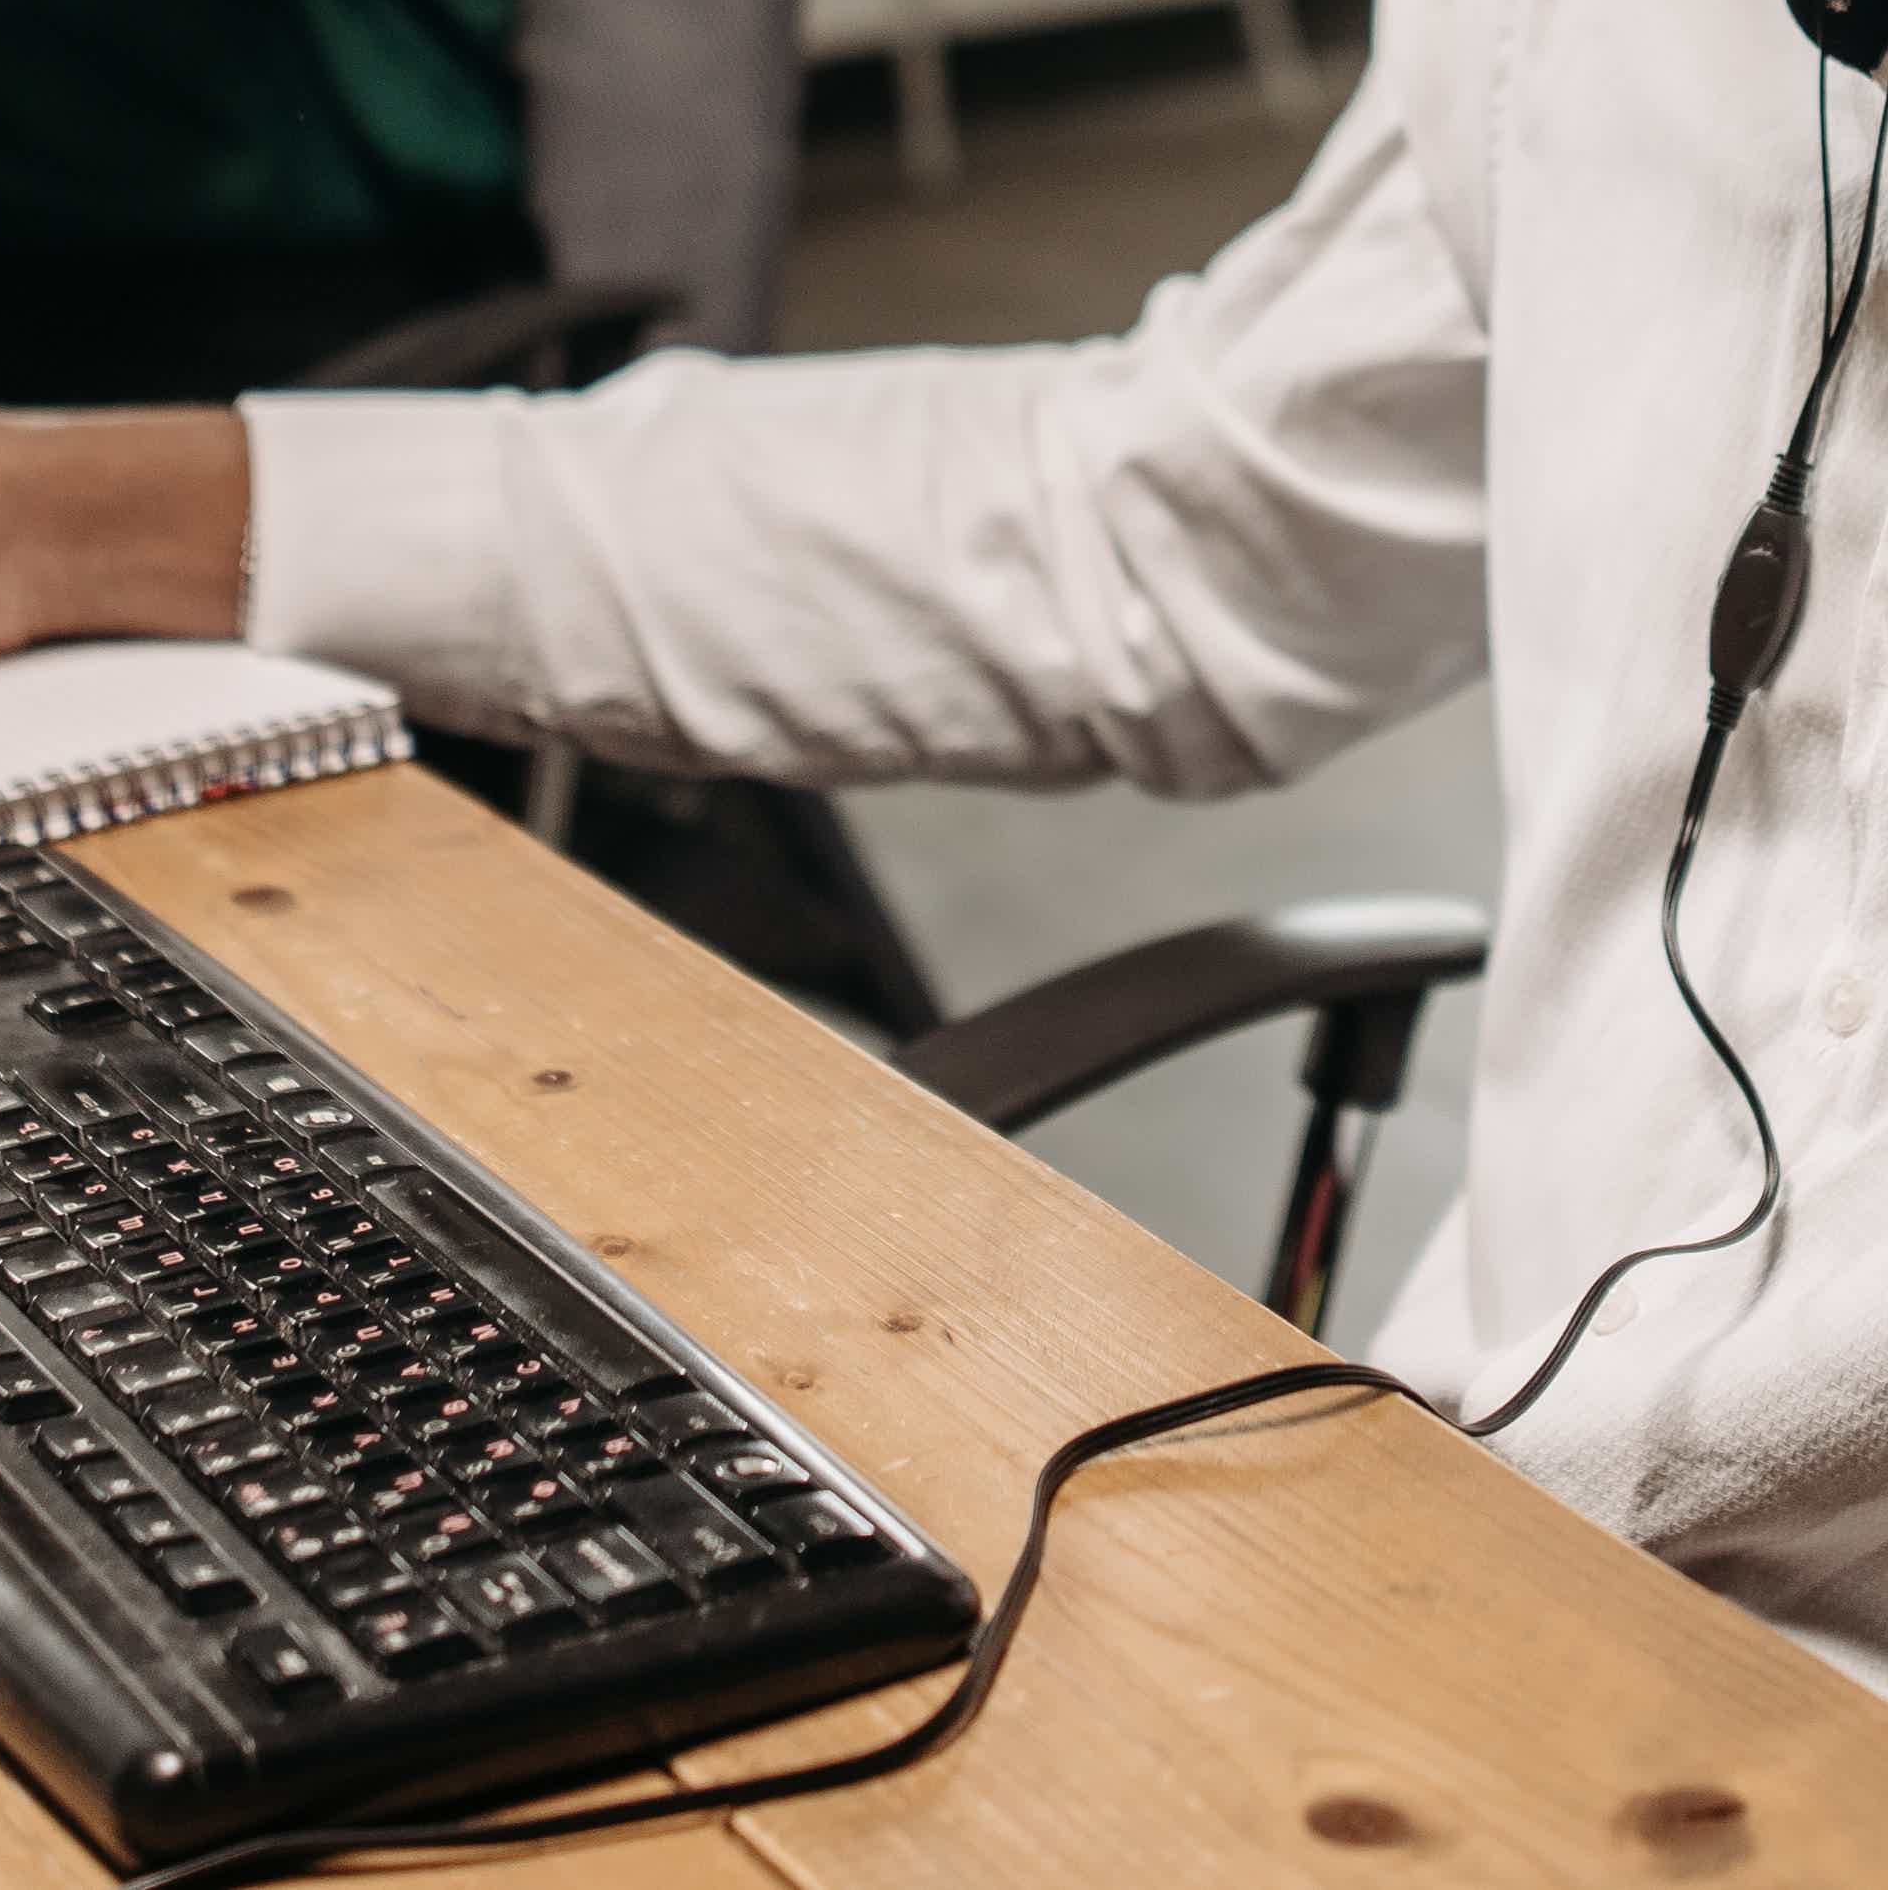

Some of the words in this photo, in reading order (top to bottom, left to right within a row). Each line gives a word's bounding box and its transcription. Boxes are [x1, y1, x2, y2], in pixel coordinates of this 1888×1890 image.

[18, 1122, 40, 1135] Ъ
[131, 1129, 155, 1141] Э
[49, 1153, 73, 1165] Х
[273, 1157, 298, 1172] Ю
[167, 1160, 194, 1174] Ж
[84, 1183, 108, 1195] З
[308, 1187, 333, 1201] Б
[198, 1190, 227, 1204] Д
[63, 1203, 87, 1213] P
[184, 1209, 206, 1219] L
[117, 1215, 144, 1231] Щ
[237, 1222, 264, 1237] Л
[353, 1221, 373, 1234] Ь
[22, 1227, 48, 1236] 0
[93, 1233, 121, 1246] O
[329, 1238, 354, 1249] M
[217, 1241, 243, 1252] K
[55, 1259, 82, 1270] 9
[156, 1253, 184, 1266] Ш
[277, 1257, 302, 1271] О
[386, 1256, 413, 1269] Т
[136, 1271, 160, 1280] I
[369, 1272, 394, 1283] N
[192, 1285, 218, 1298] Г
[315, 1289, 343, 1306] Р
[430, 1287, 454, 1302] И
[93, 1296, 116, 1307] 8
[173, 1303, 198, 1314] U
[295, 1308, 321, 1321] H
[411, 1307, 436, 1318] B
[233, 1317, 257, 1334] Н
[469, 1322, 497, 1342] М
[357, 1326, 381, 1342] П
[210, 1339, 234, 1351] Y
[336, 1344, 361, 1358] G
[452, 1345, 475, 1359] V
[271, 1355, 297, 1370] Е
[516, 1361, 541, 1374] С
[400, 1363, 427, 1379] А
[251, 1376, 274, 1387] T
[496, 1379, 521, 1391] C
[312, 1392, 337, 1408] К
[294, 1412, 316, 1427] R
